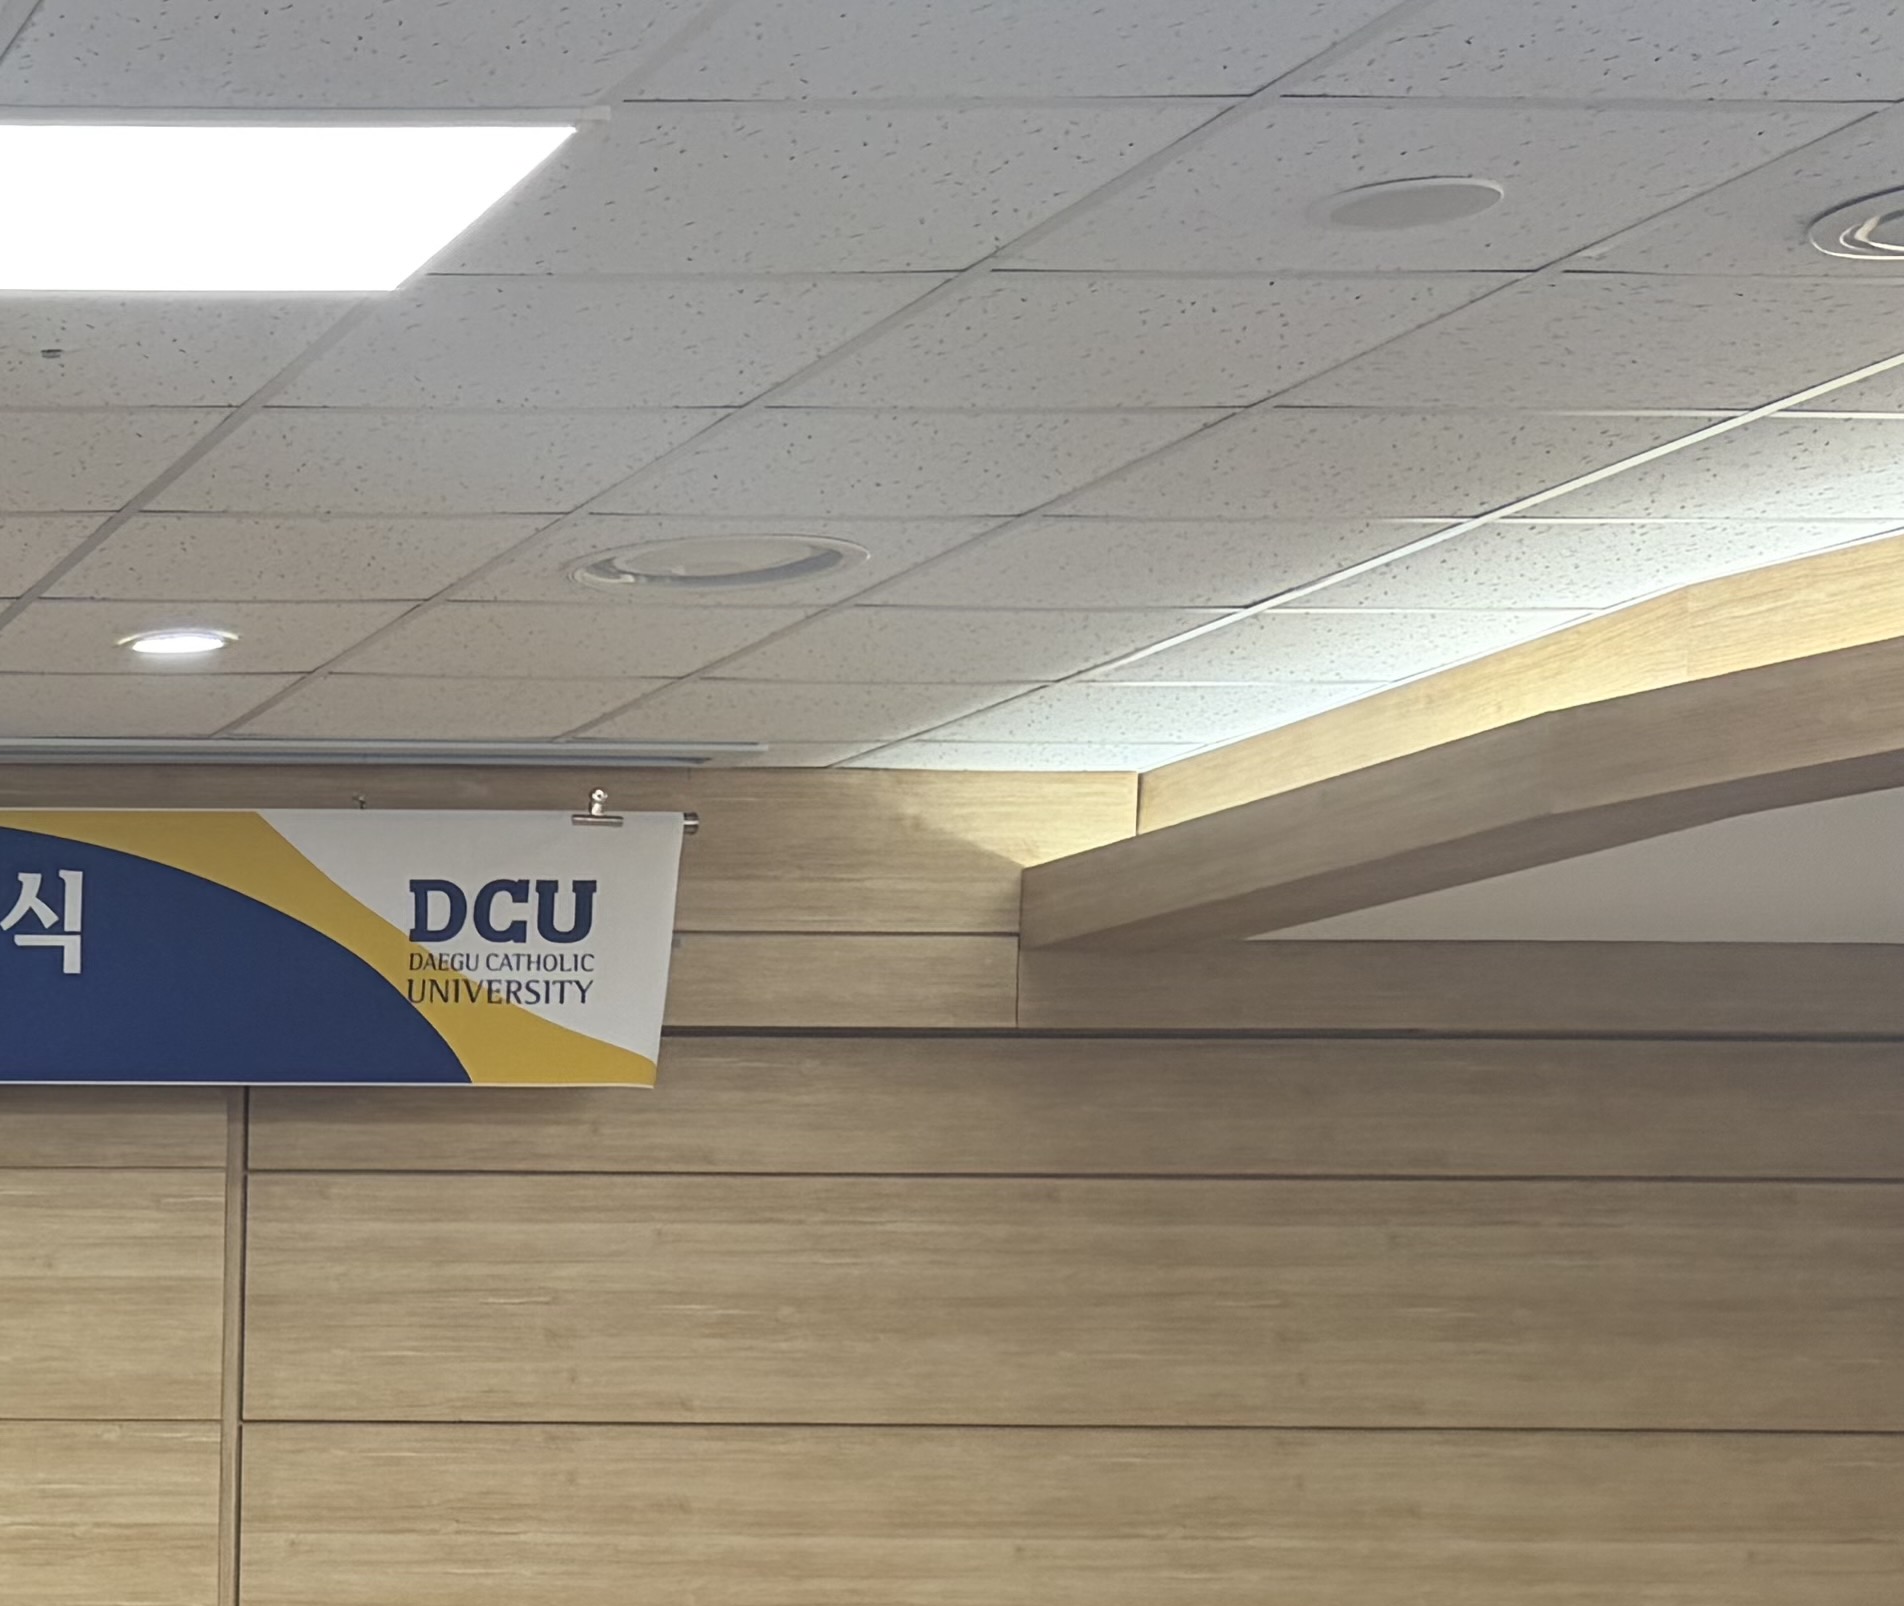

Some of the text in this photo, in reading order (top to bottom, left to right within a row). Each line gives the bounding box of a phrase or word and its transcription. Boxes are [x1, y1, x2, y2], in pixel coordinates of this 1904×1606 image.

[409, 879, 597, 943] DCU
[409, 952, 595, 972] DAEGU CATHOLIC
[407, 978, 594, 1005] UNIVERSITY
